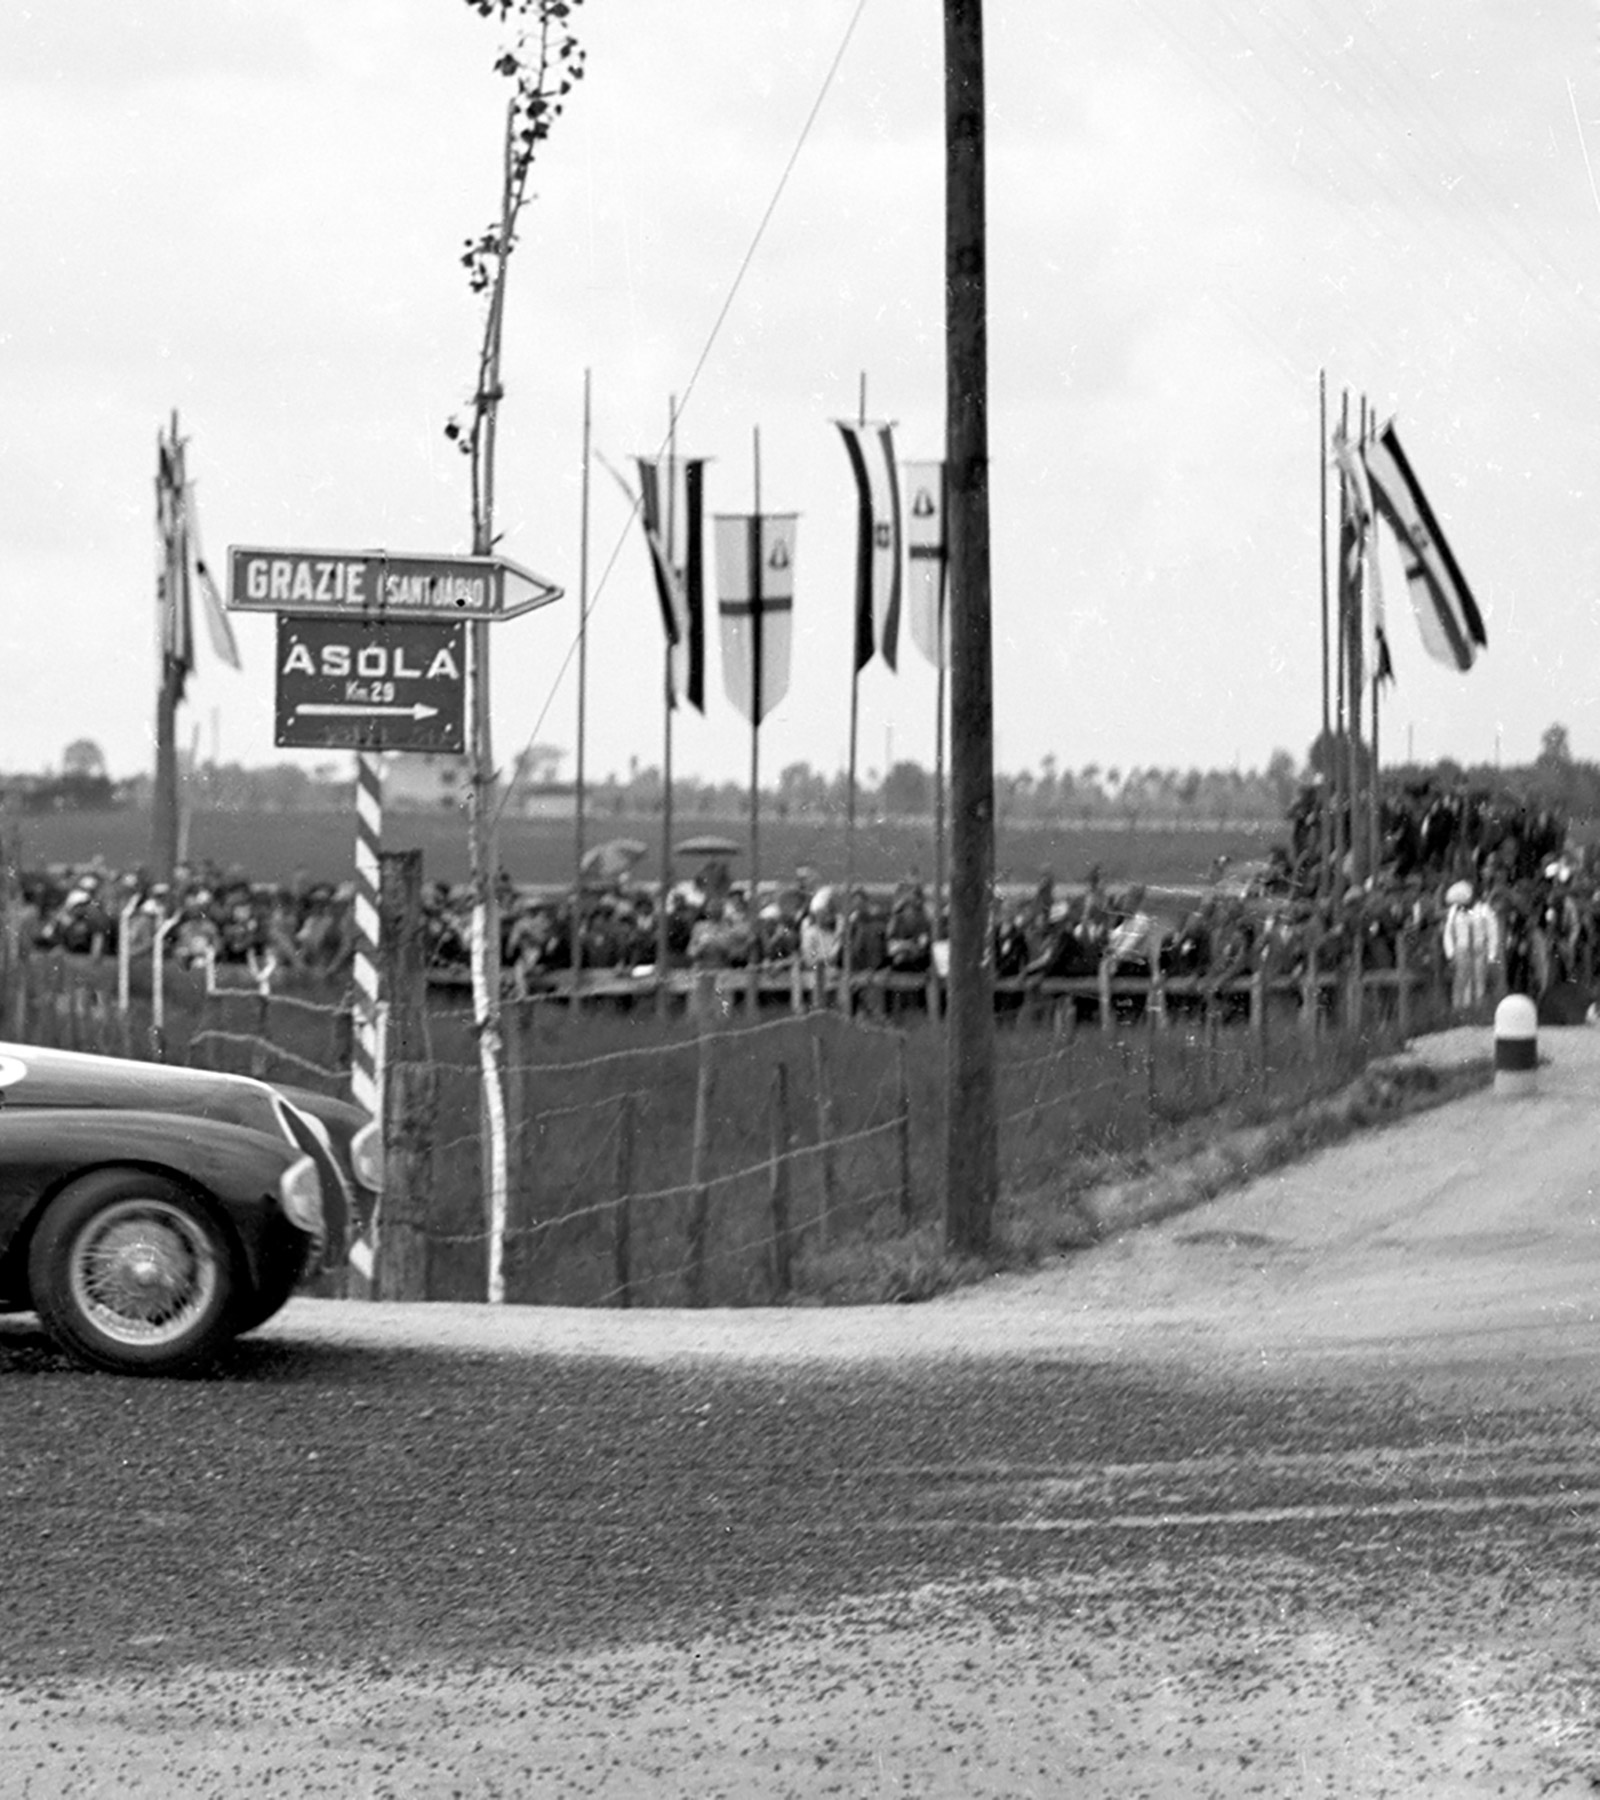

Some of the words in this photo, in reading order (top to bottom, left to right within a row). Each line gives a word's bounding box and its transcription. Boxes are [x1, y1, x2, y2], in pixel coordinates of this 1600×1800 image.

[246, 560, 367, 604] GRAZIE
[282, 643, 460, 680] ASOLA
[370, 680, 396, 703] 29
